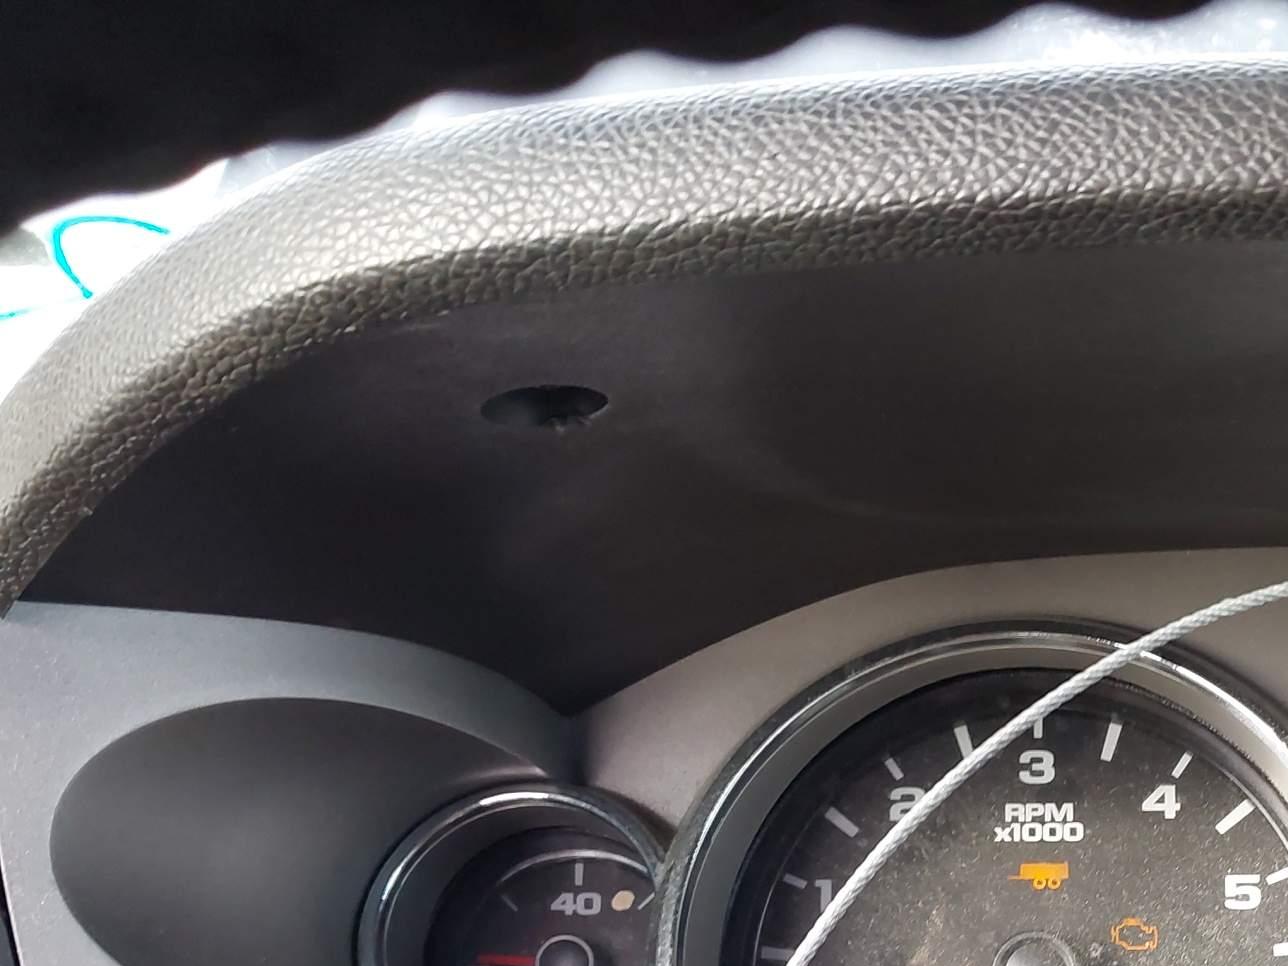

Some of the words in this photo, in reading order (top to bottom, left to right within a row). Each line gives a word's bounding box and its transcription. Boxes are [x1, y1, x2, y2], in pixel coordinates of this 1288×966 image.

[1018, 750, 1055, 784] 3
[889, 786, 927, 822] 2
[1004, 803, 1074, 822] RPM
[1141, 785, 1181, 819] 4
[994, 823, 1084, 842] x1000
[550, 892, 602, 916] 40
[1224, 874, 1262, 910] 5
